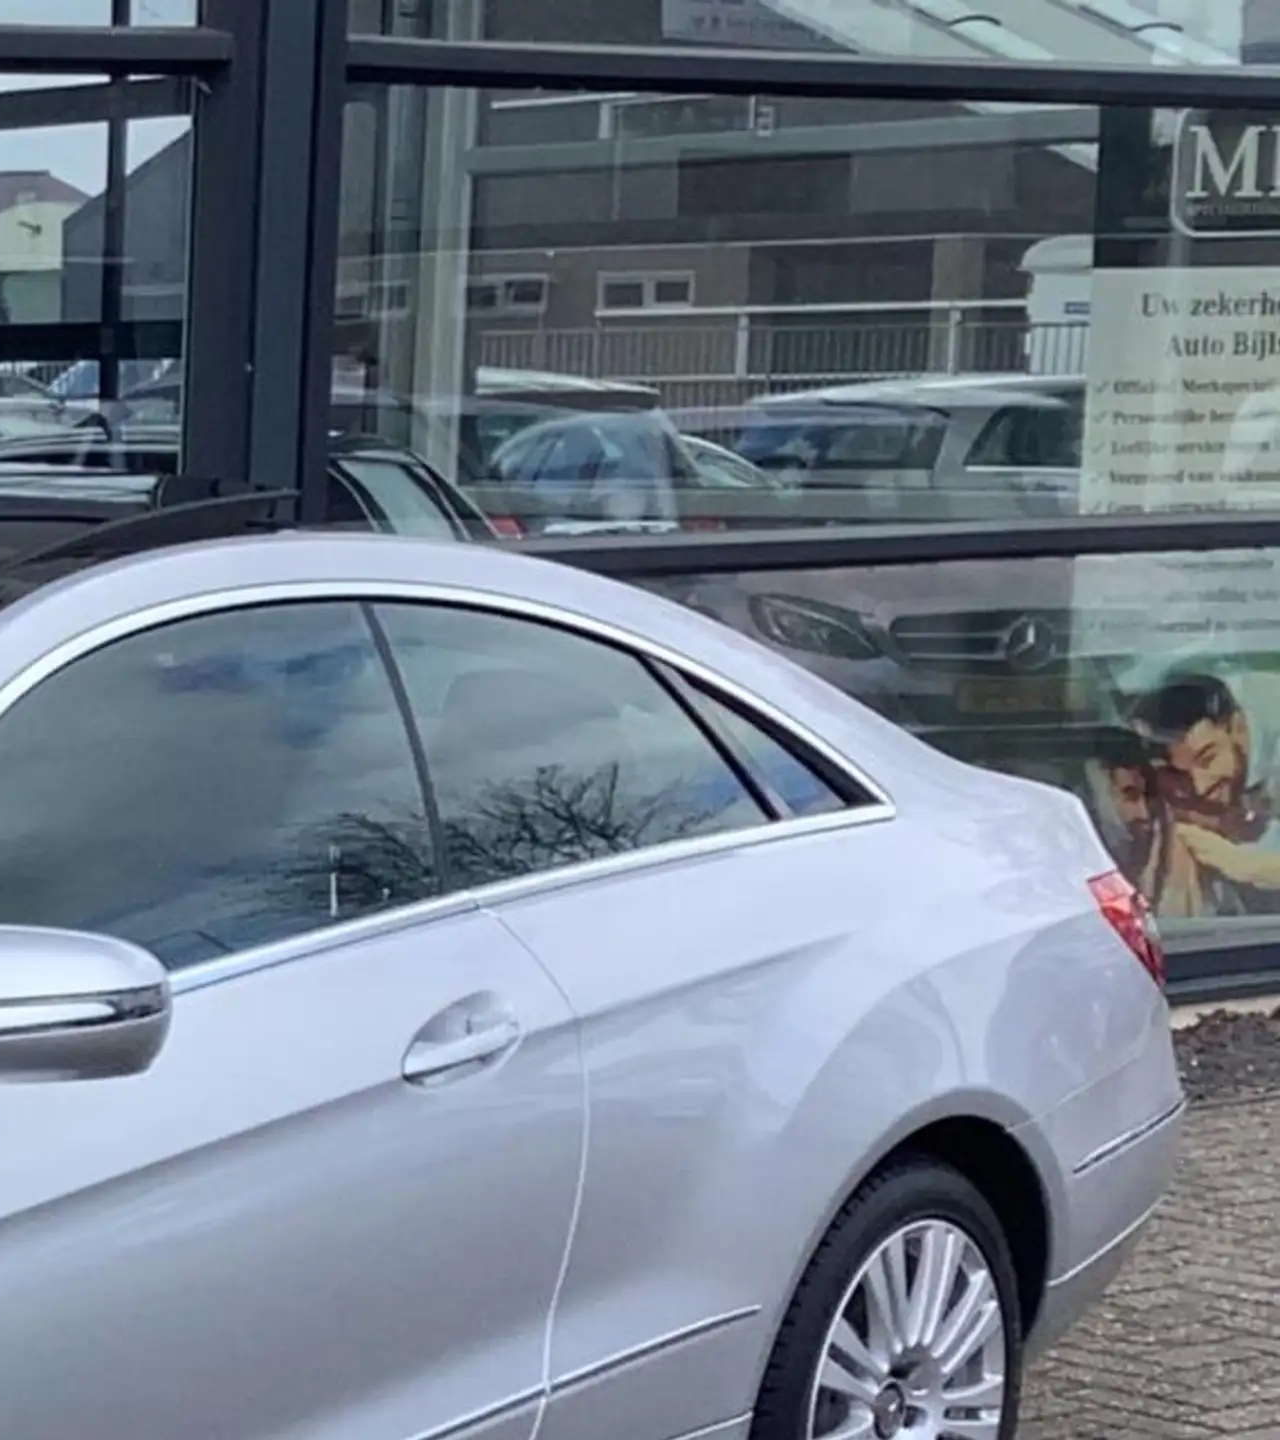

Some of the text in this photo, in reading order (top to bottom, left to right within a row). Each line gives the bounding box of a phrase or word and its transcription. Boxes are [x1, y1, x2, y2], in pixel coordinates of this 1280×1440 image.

[1184, 125, 1280, 198] M
[1189, 289, 1280, 318] zekerh
[1166, 329, 1280, 362] Auto Bijl
